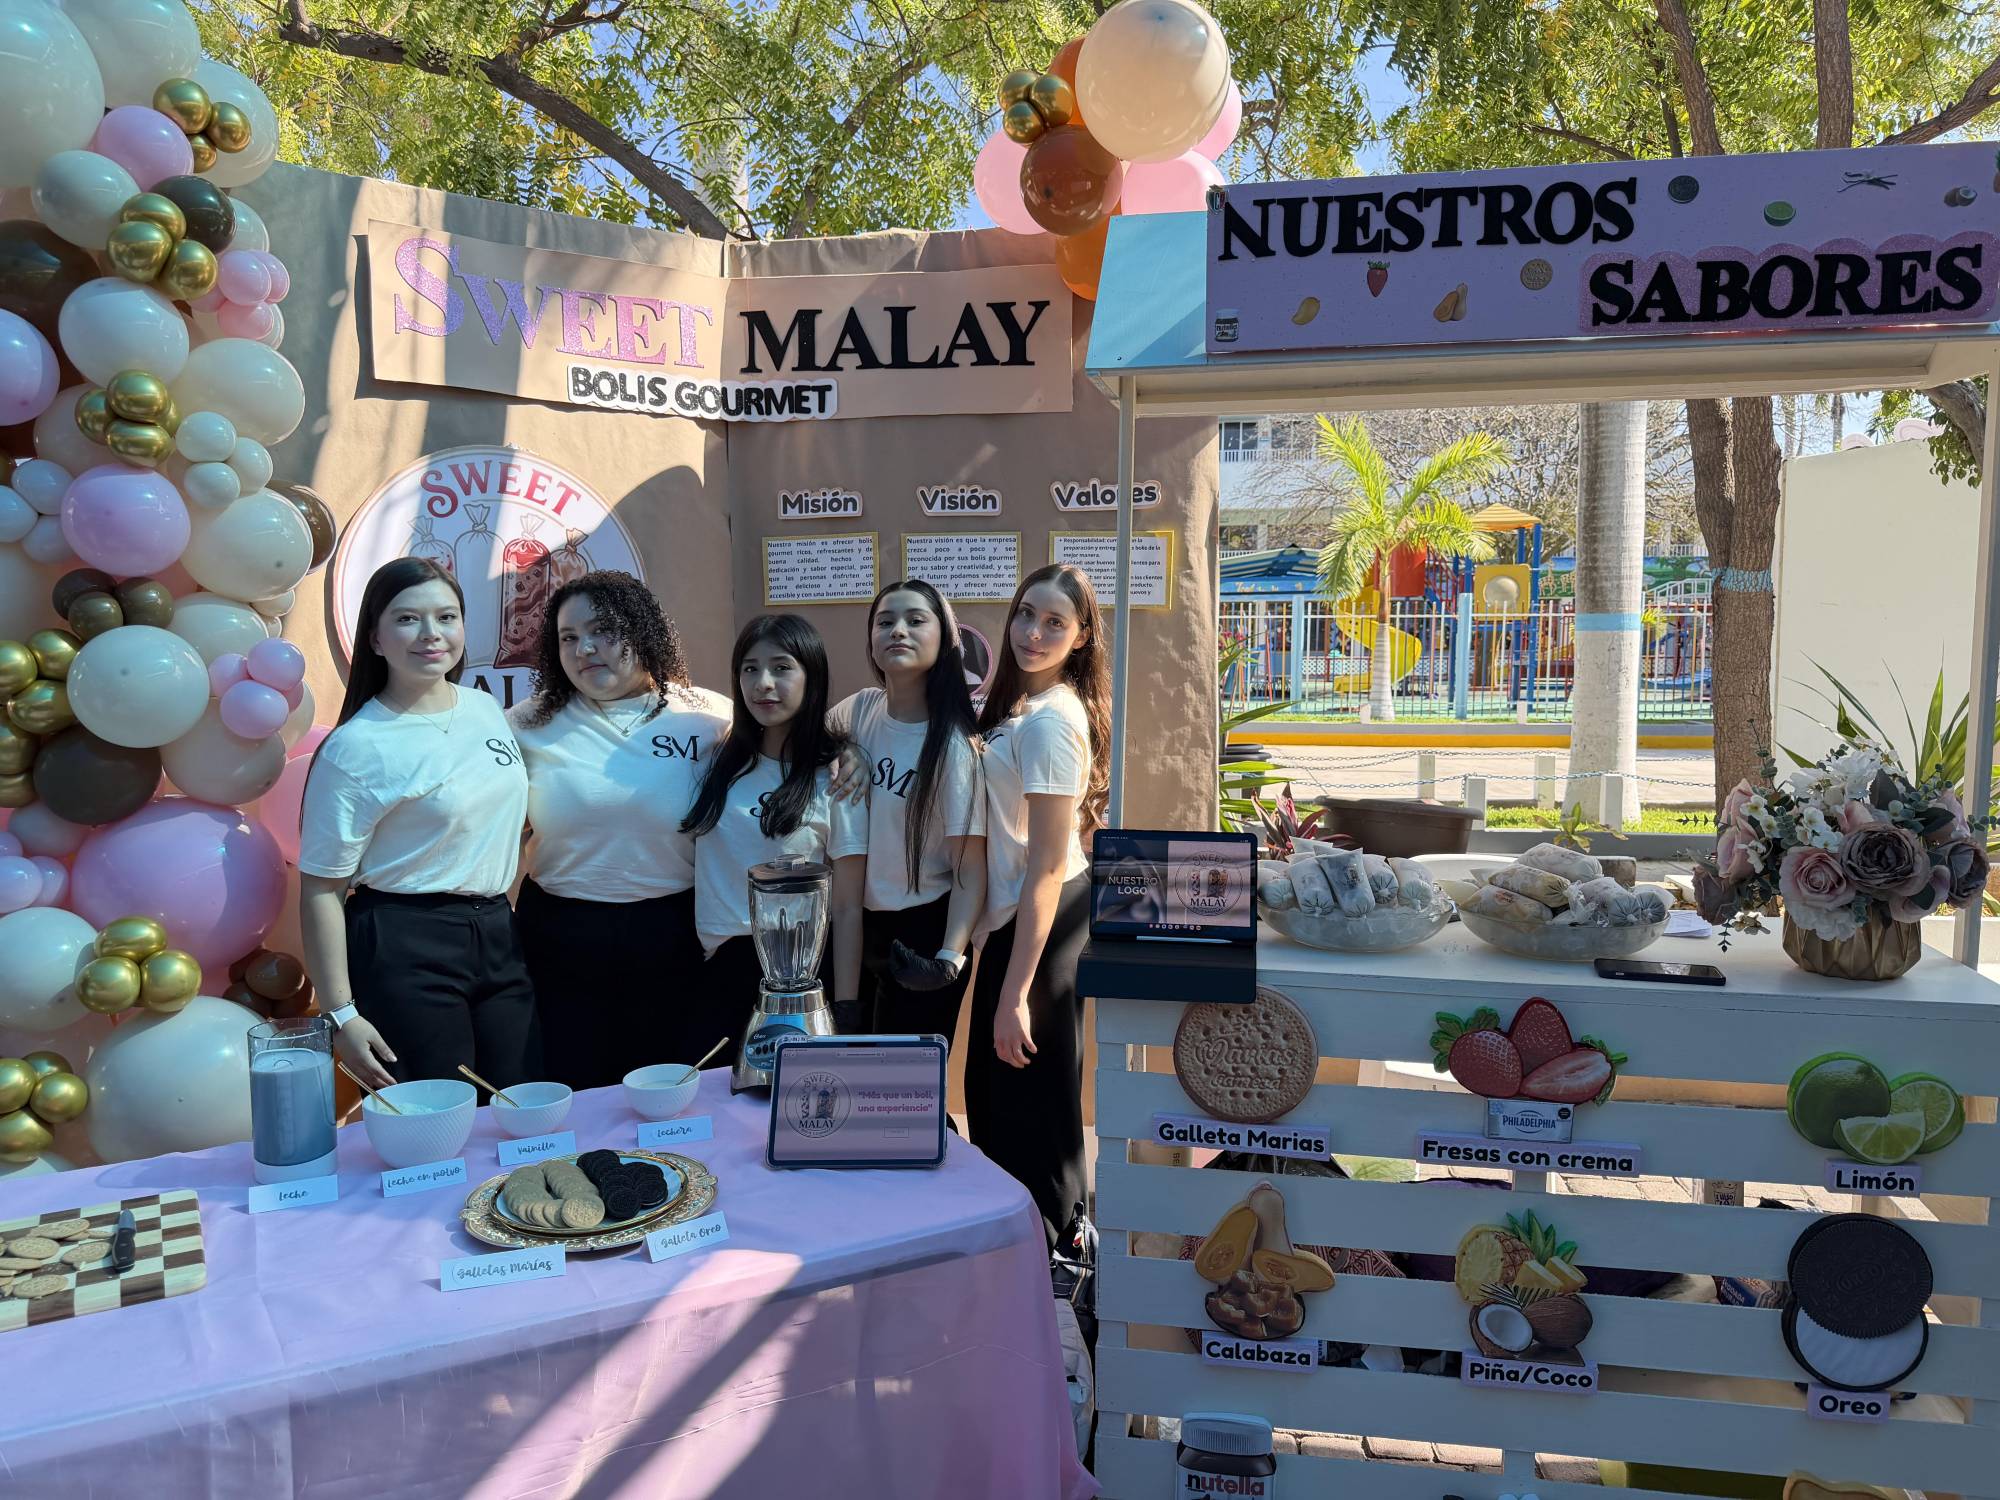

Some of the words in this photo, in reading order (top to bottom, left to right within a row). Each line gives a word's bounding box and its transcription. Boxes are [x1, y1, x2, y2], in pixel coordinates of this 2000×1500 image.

[1218, 178, 1637, 262] NUESTROS
[1589, 244, 1984, 327] SABORES
[393, 237, 713, 368] SWEET
[740, 301, 1050, 374] MALAY
[571, 366, 668, 406] BOLIS
[677, 380, 833, 417] GOURMET
[421, 460, 581, 518] SWEET
[921, 488, 997, 511] Visión
[1054, 483, 1157, 507] Valoes
[782, 492, 857, 514] Misión
[1108, 876, 1158, 886] NUESTRO
[1118, 886, 1148, 895] LOGO
[1190, 898, 1228, 907] MALAY
[804, 1075, 835, 1088] SWEET
[884, 1092, 899, 1100] que
[799, 1119, 835, 1128] MALAY
[1502, 1114, 1556, 1128] PHILADELPHIA
[1159, 1122, 1242, 1146] Galleta
[1248, 1130, 1325, 1153] Marias
[1423, 1139, 1501, 1163] Fresas
[1508, 1150, 1549, 1167] con
[1557, 1153, 1633, 1171] crema
[1836, 1169, 1916, 1192] Limón
[699, 1224, 721, 1238] Oreo
[1205, 1340, 1311, 1365] Calabaza
[1469, 1361, 1593, 1389] Piña/Coco
[1819, 1393, 1881, 1417] Oreo
[1188, 1473, 1264, 1496] nutella
